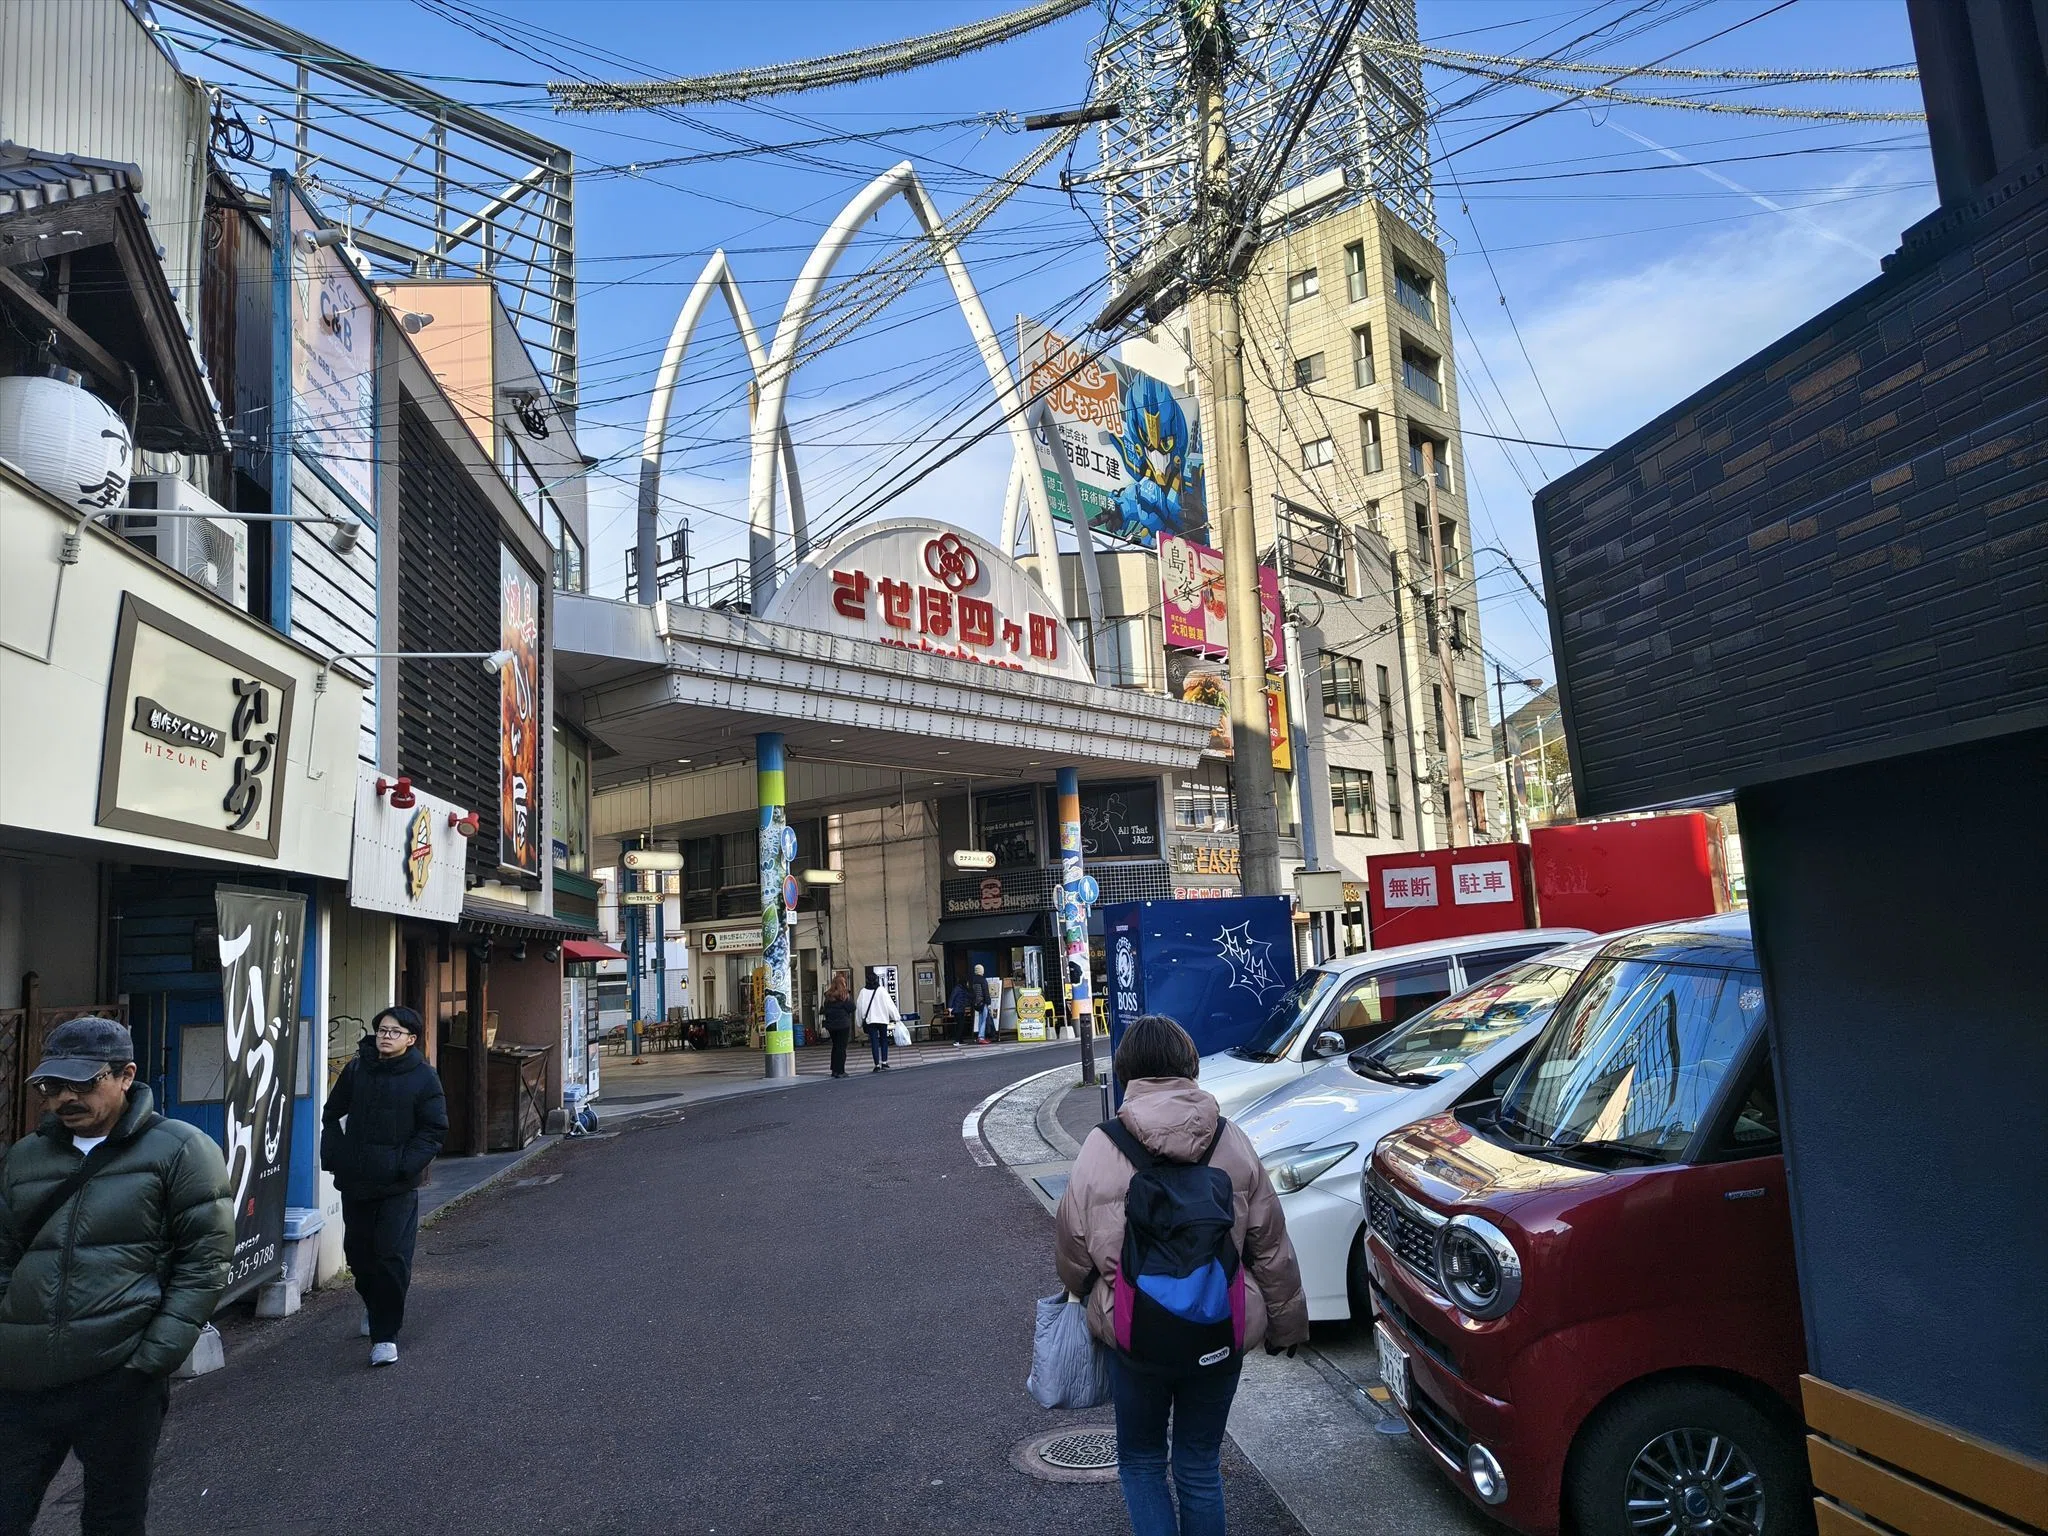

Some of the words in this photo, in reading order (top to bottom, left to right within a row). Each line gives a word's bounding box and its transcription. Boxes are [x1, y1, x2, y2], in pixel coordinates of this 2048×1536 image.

[831, 569, 1058, 662] させぼ四ヶ町
[1171, 622, 1205, 642] 大和製菓
[149, 708, 219, 749] 創作ダイニング
[143, 741, 209, 772] HIZUME
[1118, 826, 1130, 835] All
[1131, 825, 1148, 834] That
[1132, 836, 1154, 845] JAZZ!
[1198, 846, 1239, 874] EASE
[1388, 876, 1431, 898] 無断
[1458, 870, 1506, 895] 駐車
[948, 898, 980, 911] Sasebo
[1003, 893, 1041, 907] Burgers
[1117, 991, 1139, 1012] BOSS
